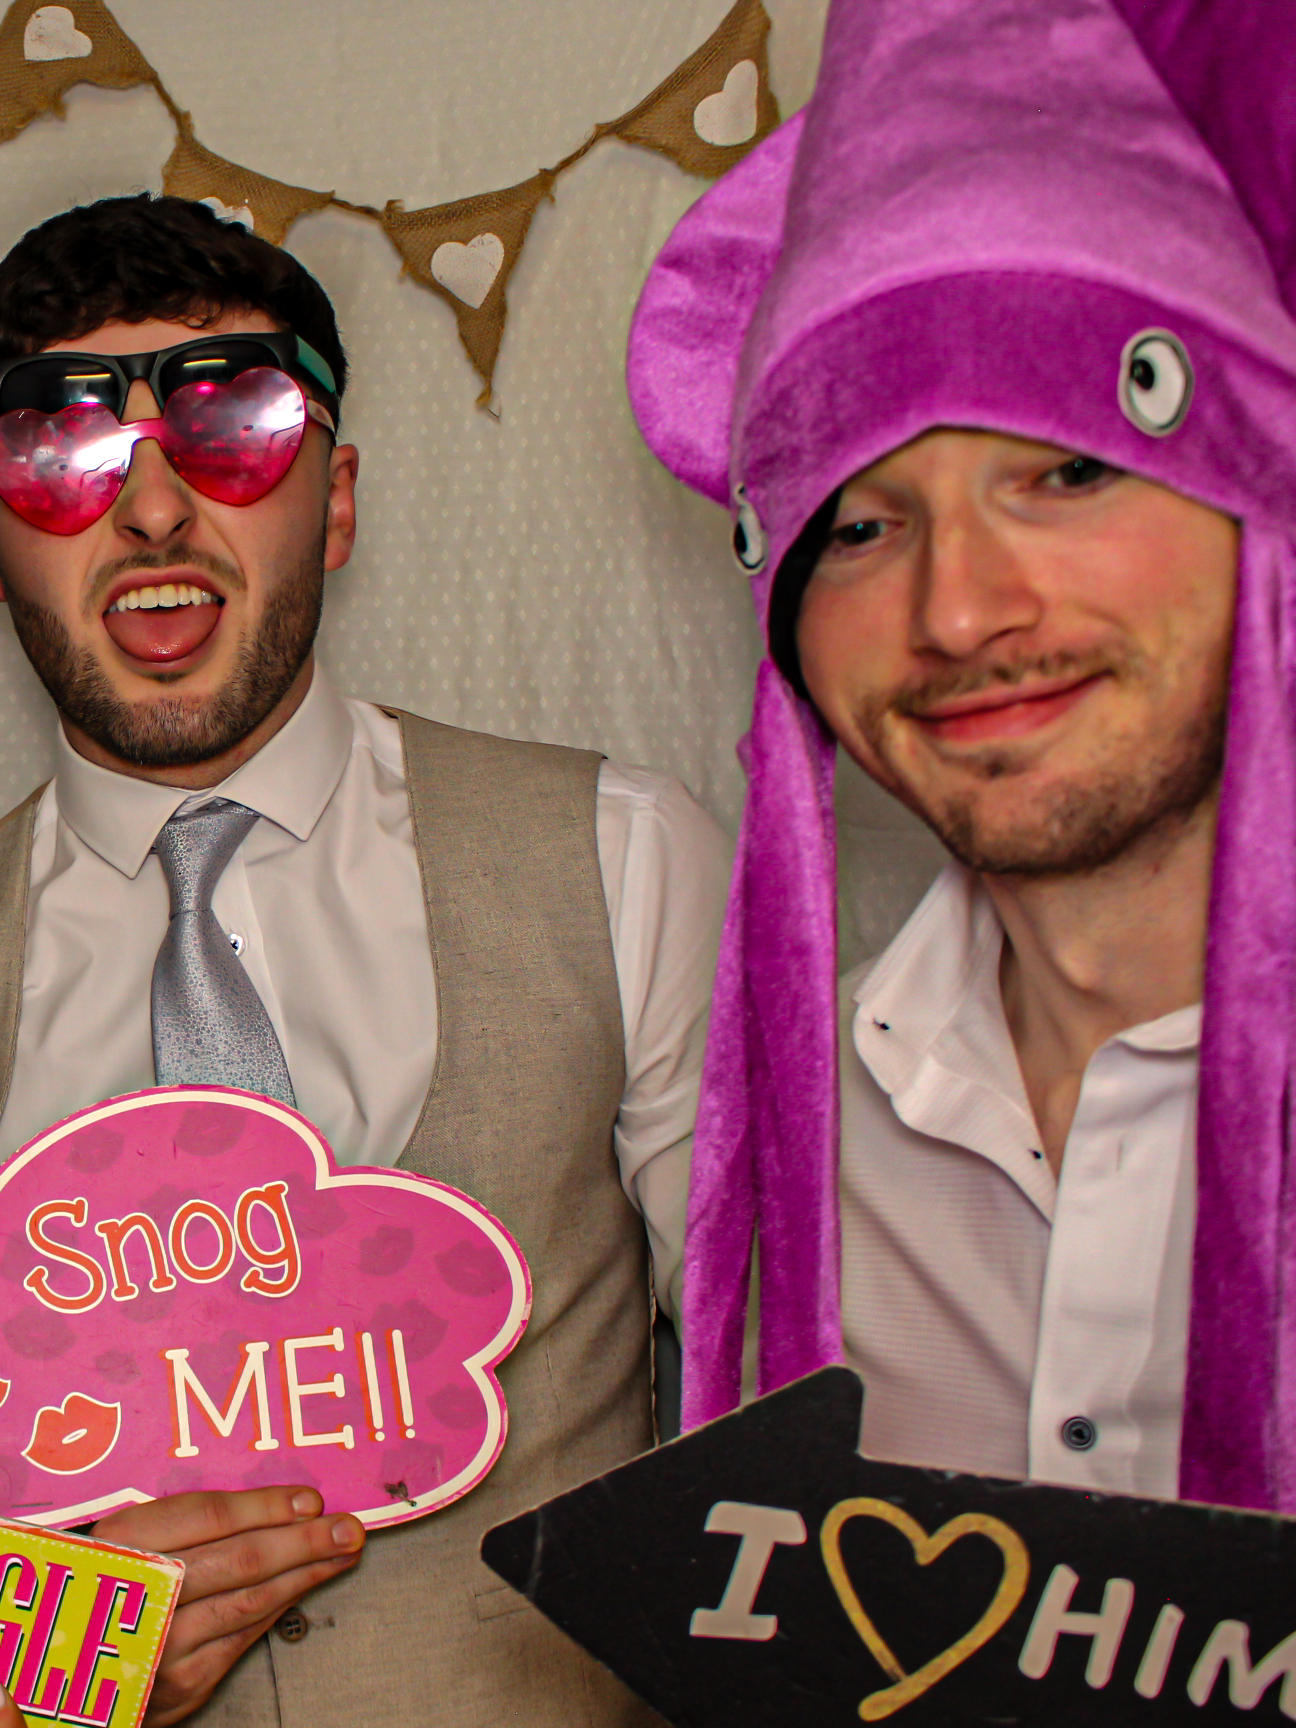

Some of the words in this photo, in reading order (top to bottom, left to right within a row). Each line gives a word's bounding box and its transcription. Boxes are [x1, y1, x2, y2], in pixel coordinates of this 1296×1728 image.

[24, 1182, 301, 1313] Snog
[164, 1327, 416, 1458] ME!!
[690, 1501, 807, 1640] I
[1019, 1564, 1296, 1720] HIM
